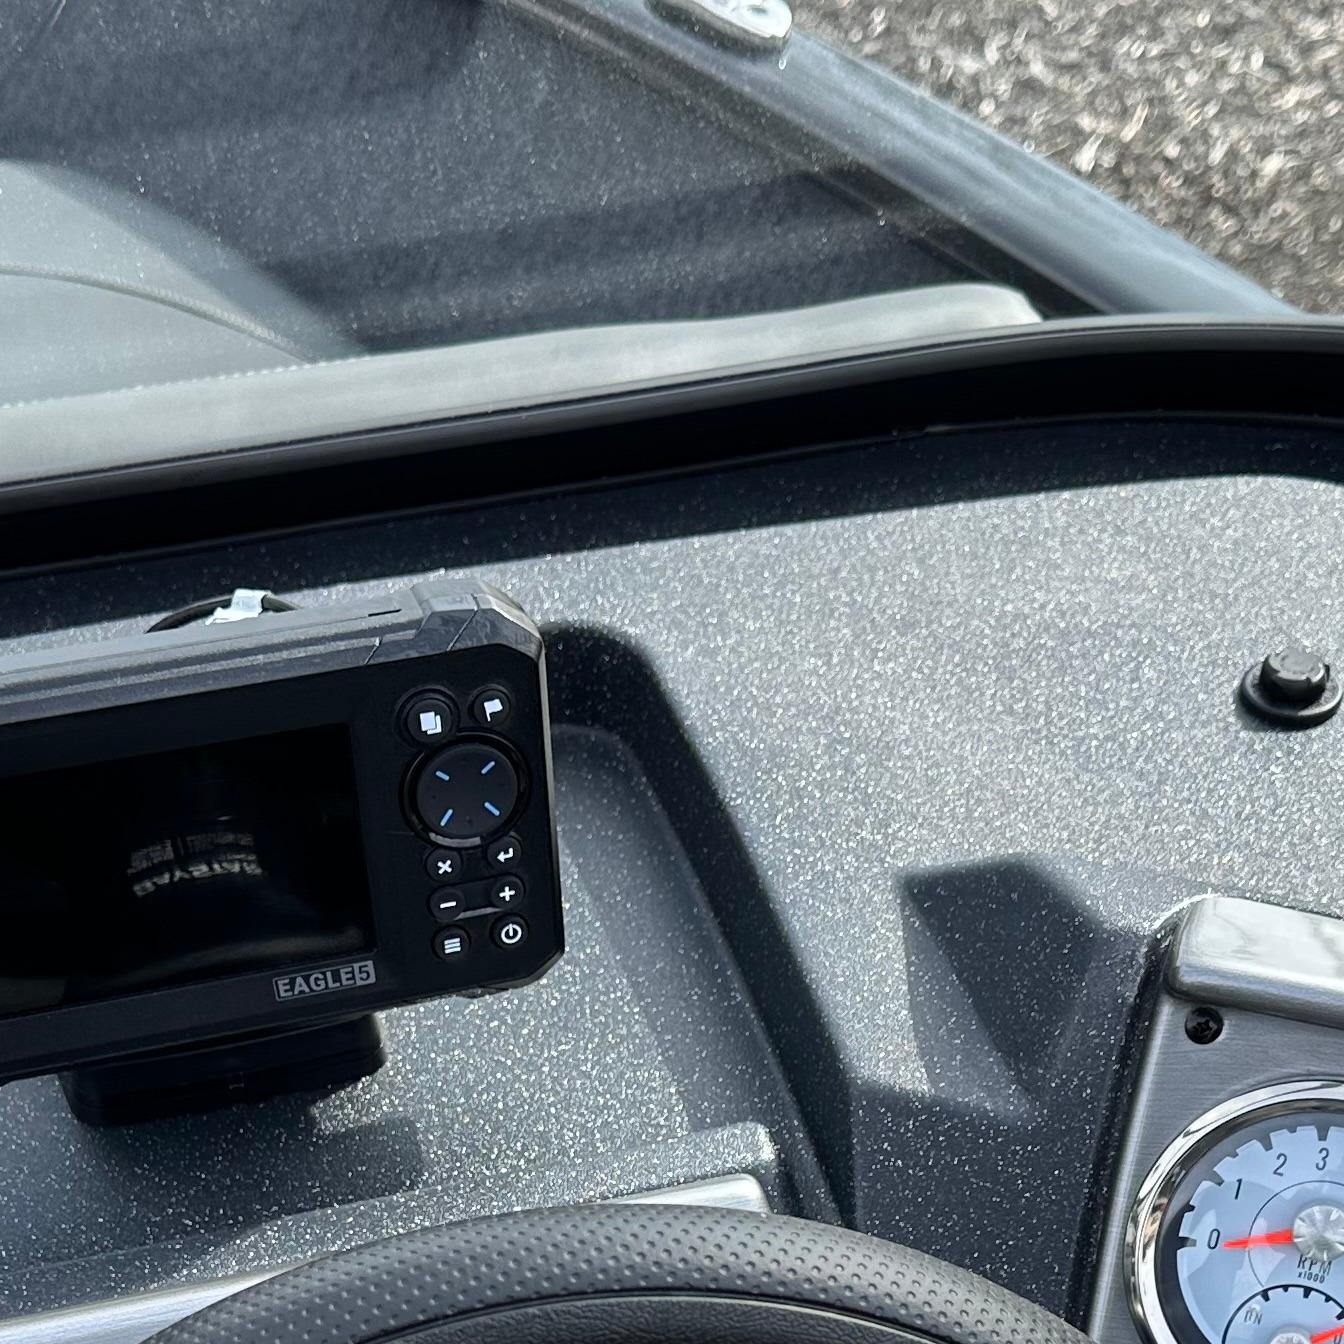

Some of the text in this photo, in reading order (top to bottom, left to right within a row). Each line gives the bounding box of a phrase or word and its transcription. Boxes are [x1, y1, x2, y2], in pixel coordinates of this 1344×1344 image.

[1273, 1154, 1287, 1176] 2
[1316, 1148, 1329, 1170] 3
[1234, 1179, 1242, 1199] 1
[1206, 1229, 1220, 1249] 0
[1297, 1254, 1332, 1275] RPM
